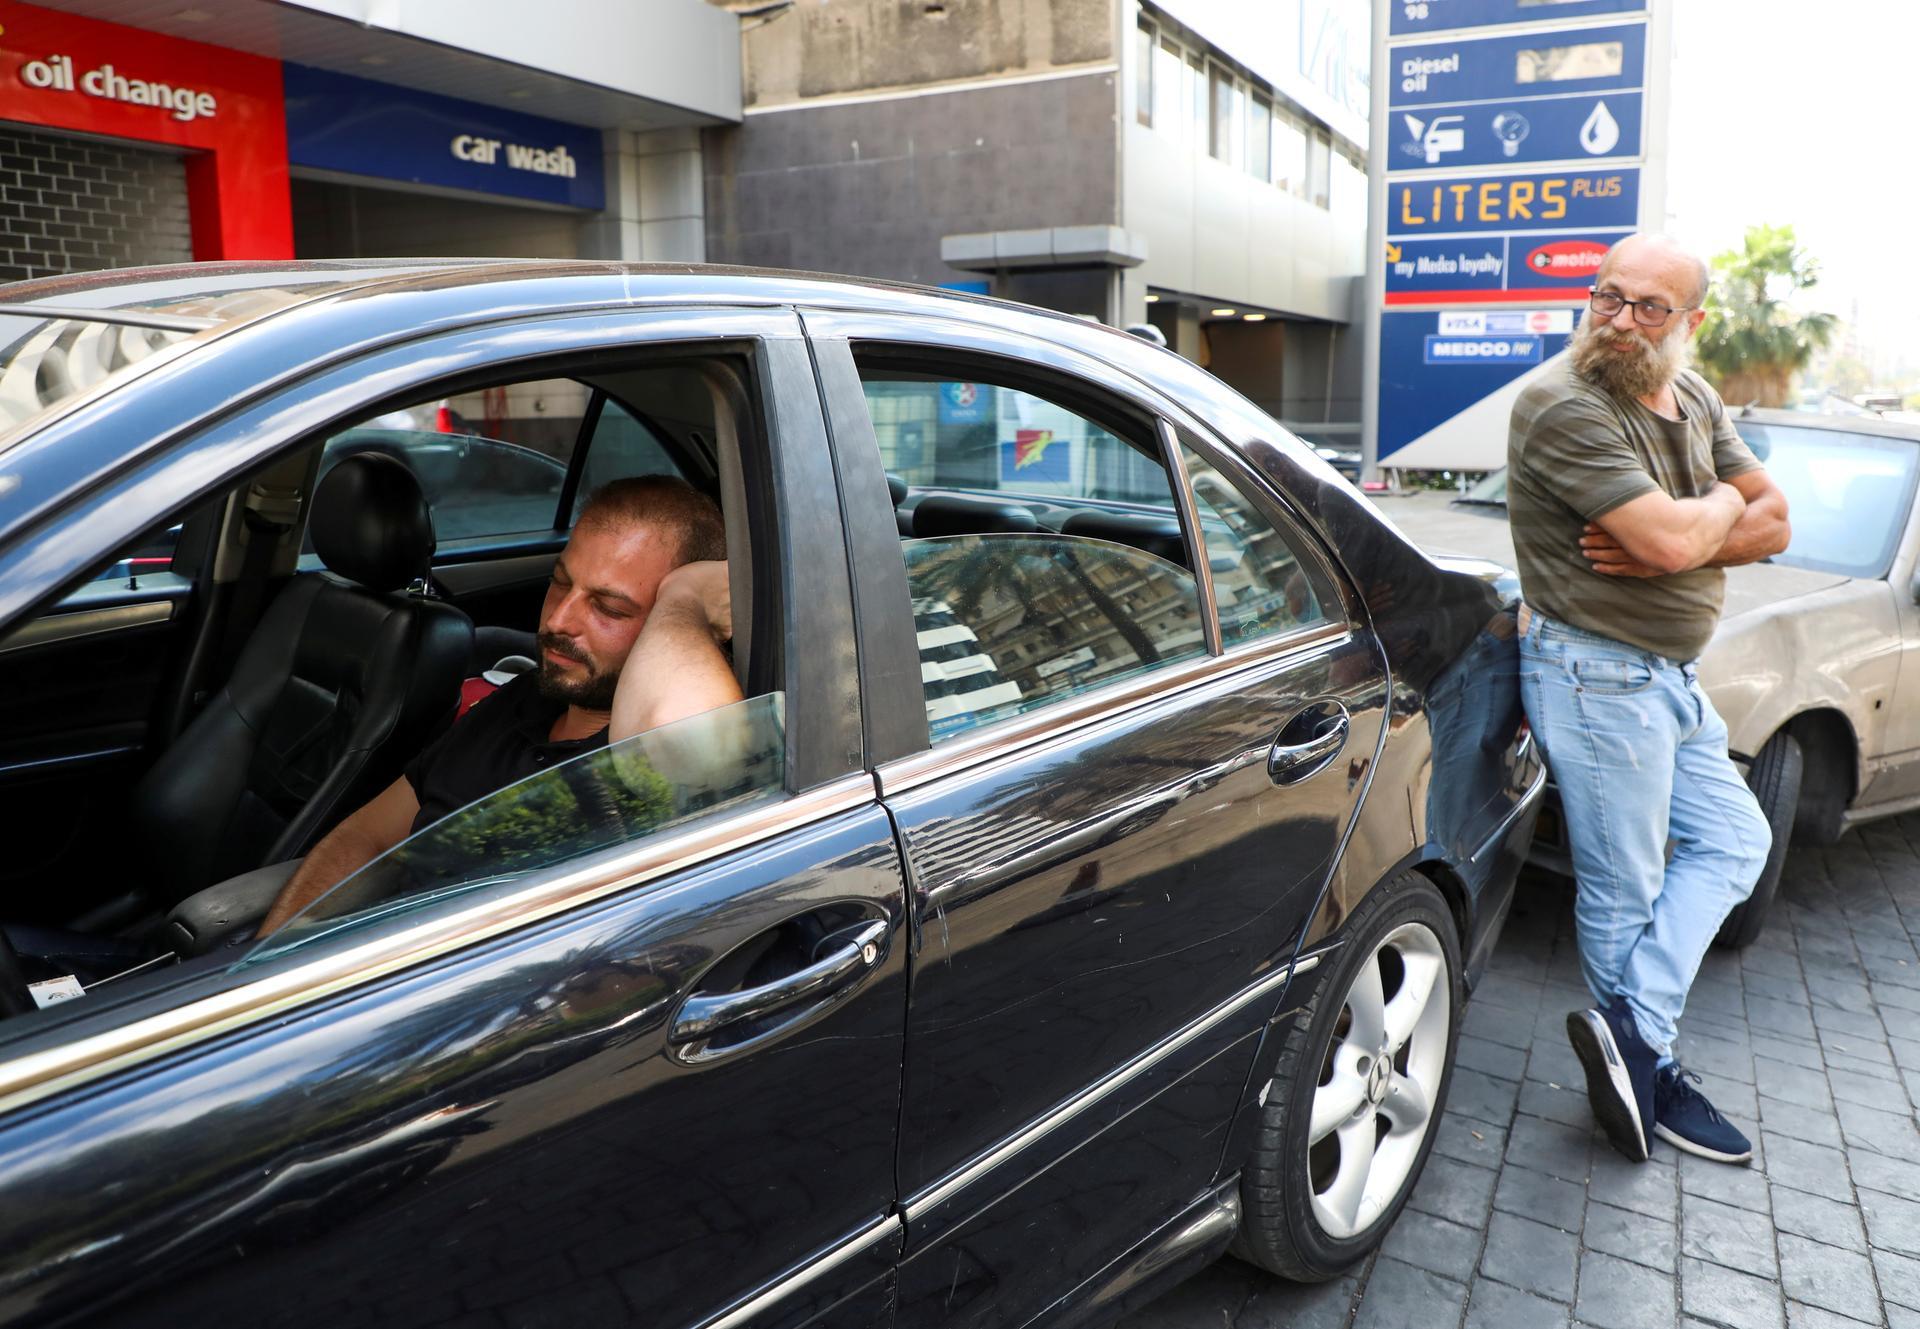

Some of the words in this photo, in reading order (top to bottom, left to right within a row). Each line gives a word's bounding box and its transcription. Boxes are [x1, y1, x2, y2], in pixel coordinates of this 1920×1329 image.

[1404, 3, 1429, 20] 98
[1402, 53, 1460, 77] Diesel
[22, 54, 75, 91] oil
[80, 64, 217, 121] change
[451, 134, 501, 165] car
[506, 145, 577, 178] wash
[1402, 179, 1567, 225] LITERS
[1571, 177, 1622, 197] PLUS
[1395, 261, 1416, 278] my
[1416, 254, 1457, 274] Medco
[1458, 251, 1503, 276] loyalty
[1446, 318, 1481, 330] VISA
[1432, 341, 1511, 357] MEDCO
[1511, 341, 1535, 356] PAY
